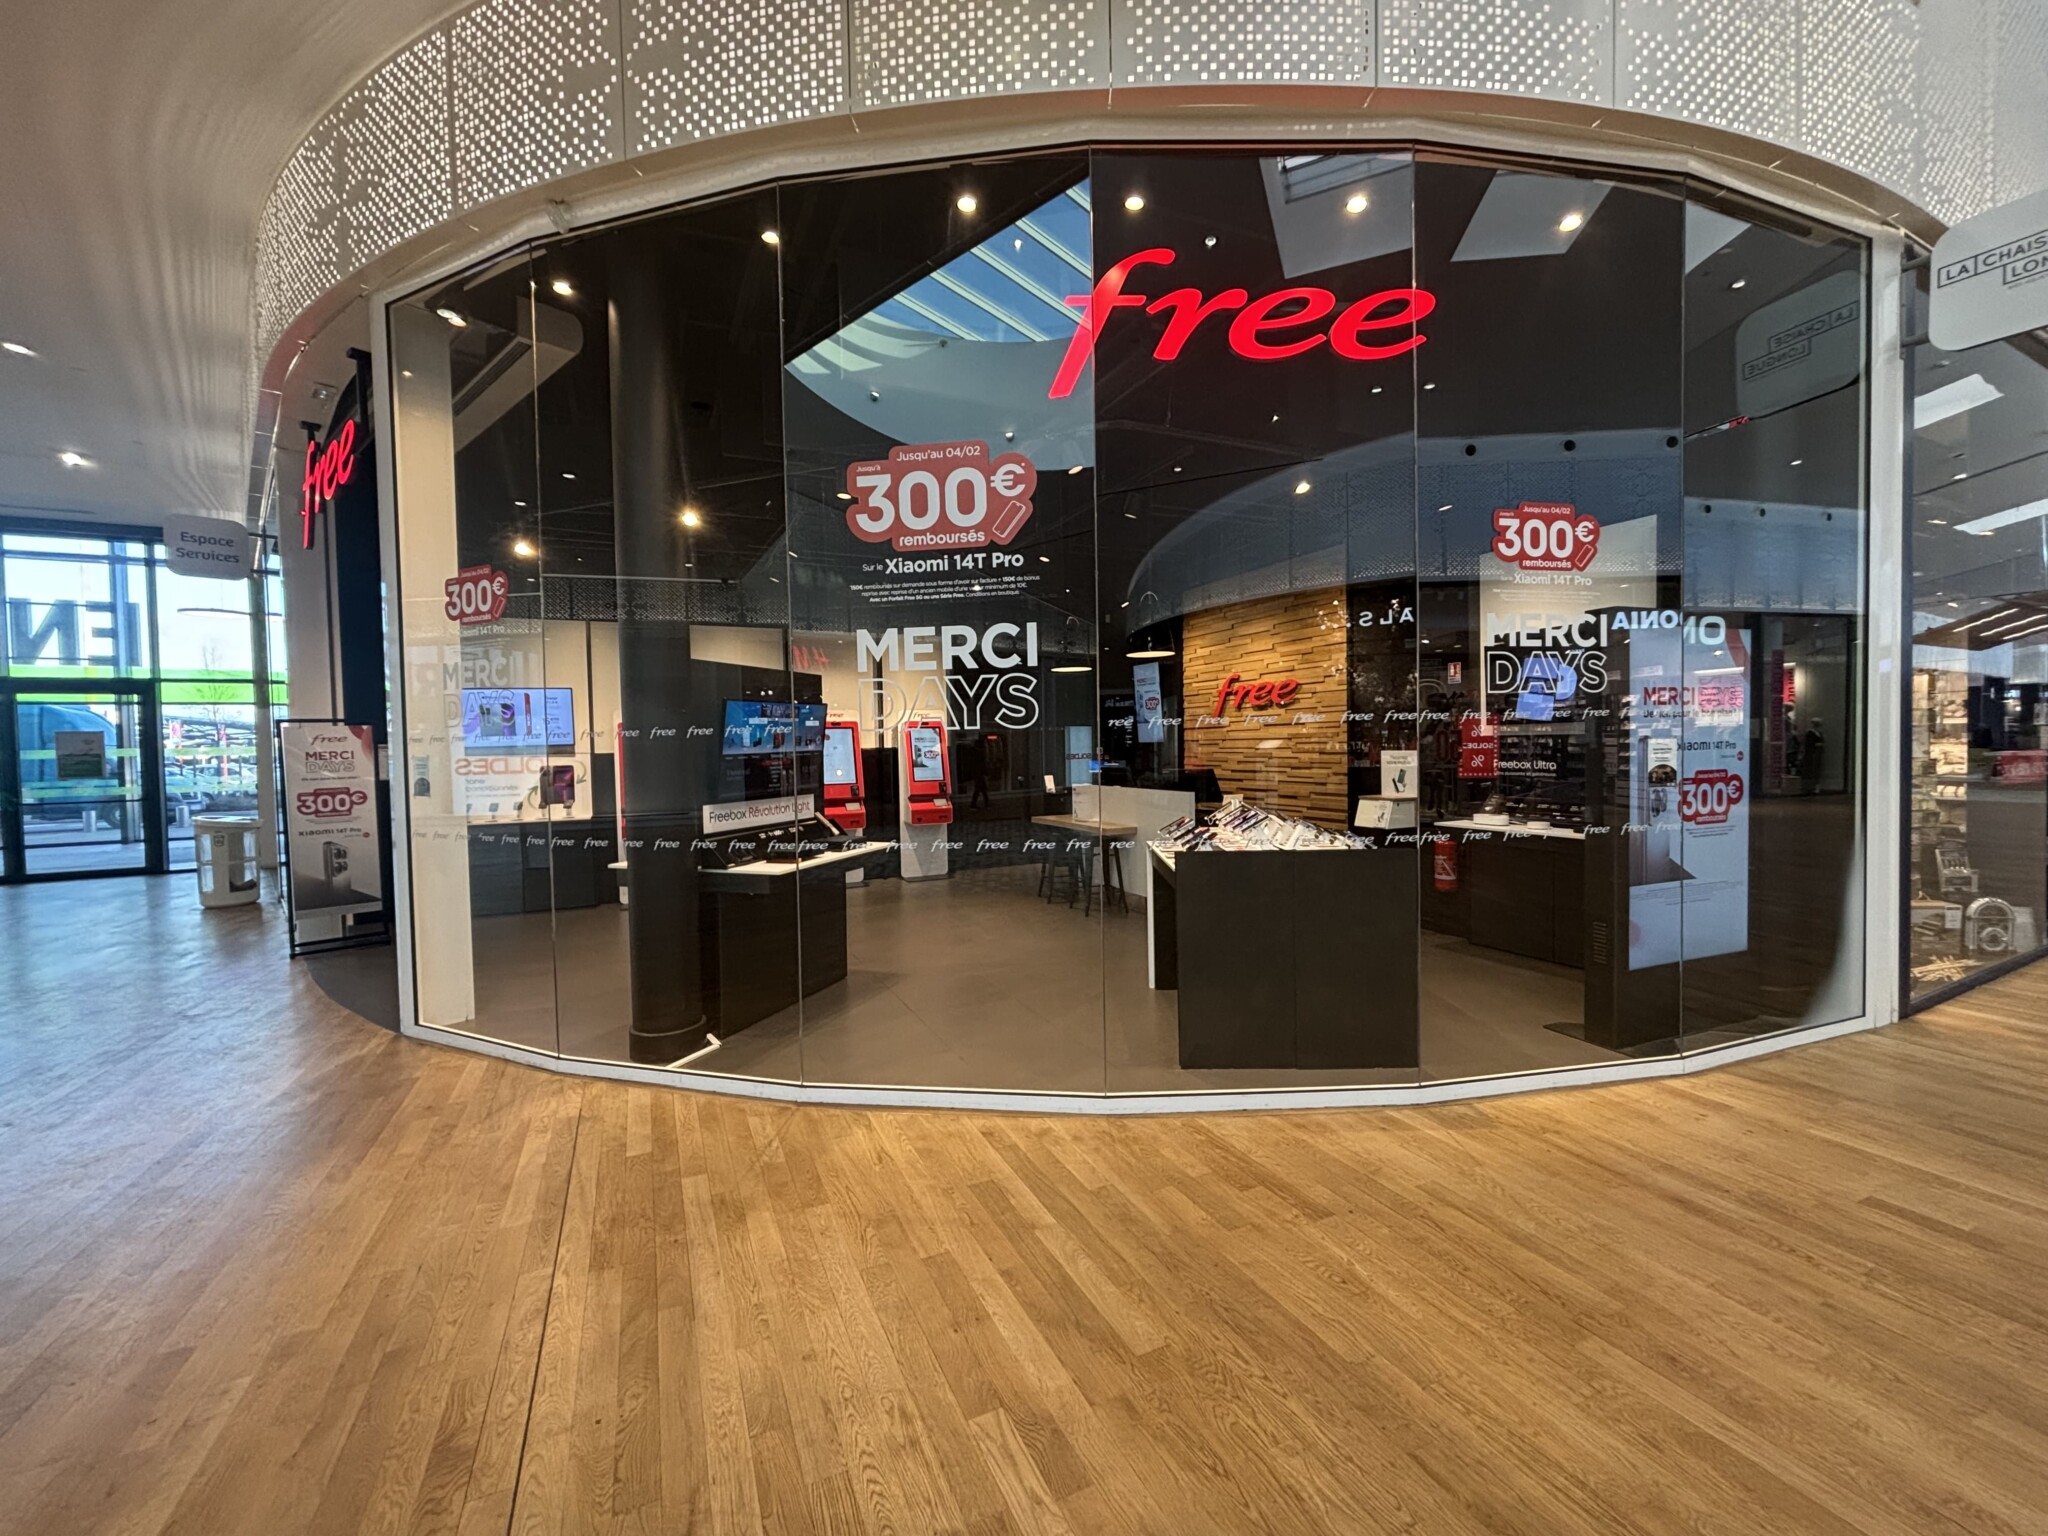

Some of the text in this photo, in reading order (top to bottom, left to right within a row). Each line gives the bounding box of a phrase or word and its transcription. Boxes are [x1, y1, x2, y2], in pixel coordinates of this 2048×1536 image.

[1947, 264, 1970, 281] LA
[1048, 248, 1437, 400] free
[896, 446, 981, 462] Jusqu'au 04/02
[856, 464, 881, 473] Jusqu'à
[302, 419, 355, 549] free
[1522, 505, 1550, 514] Jusqu'au
[180, 531, 235, 548] Espace
[899, 529, 985, 547] remboursés
[176, 548, 240, 564] Services
[862, 552, 1024, 575] Sur le Xiaomi 14T Pro
[1522, 559, 1571, 568] remboursés
[1514, 573, 1593, 586] Xiaomi 14T Pro
[1486, 612, 1607, 647] MERCI
[856, 622, 1039, 673] MERCI
[443, 656, 515, 691] MERCI
[1486, 650, 1608, 694] DAYS
[857, 672, 1040, 733] DAYS
[1214, 673, 1299, 718] free
[1643, 686, 1695, 706] MERCI
[1148, 715, 1182, 729] free
[1196, 714, 1230, 728] free
[1244, 713, 1279, 727] free
[1340, 710, 1374, 724] free
[1384, 710, 1417, 723] free
[1419, 709, 1450, 723] free
[1459, 709, 1491, 724] free
[1503, 708, 1531, 722] free
[1582, 706, 1610, 720] free
[311, 734, 348, 746] free
[580, 729, 605, 741] free
[650, 725, 676, 739] free
[686, 724, 713, 738] free
[724, 723, 752, 738] free
[763, 723, 792, 737] free
[305, 750, 355, 761] MERCI
[305, 760, 355, 773] DAYS
[1493, 760, 1557, 770] Freebox Ultra
[709, 800, 810, 824] Freebox Révolution Lght
[500, 833, 520, 845] free
[526, 833, 546, 846] free
[1385, 832, 1418, 846] free
[1420, 831, 1451, 845] free
[1462, 829, 1492, 843] free
[1583, 824, 1610, 837] free
[1620, 822, 1648, 836] free
[550, 835, 575, 848] free
[583, 837, 609, 849] free
[653, 838, 680, 851] free
[690, 838, 717, 851] free
[728, 838, 756, 853] free
[767, 838, 796, 853] free
[798, 840, 829, 853] free
[886, 839, 918, 853] free
[931, 838, 964, 853] free
[976, 838, 1009, 852] free
[1023, 838, 1056, 852] free
